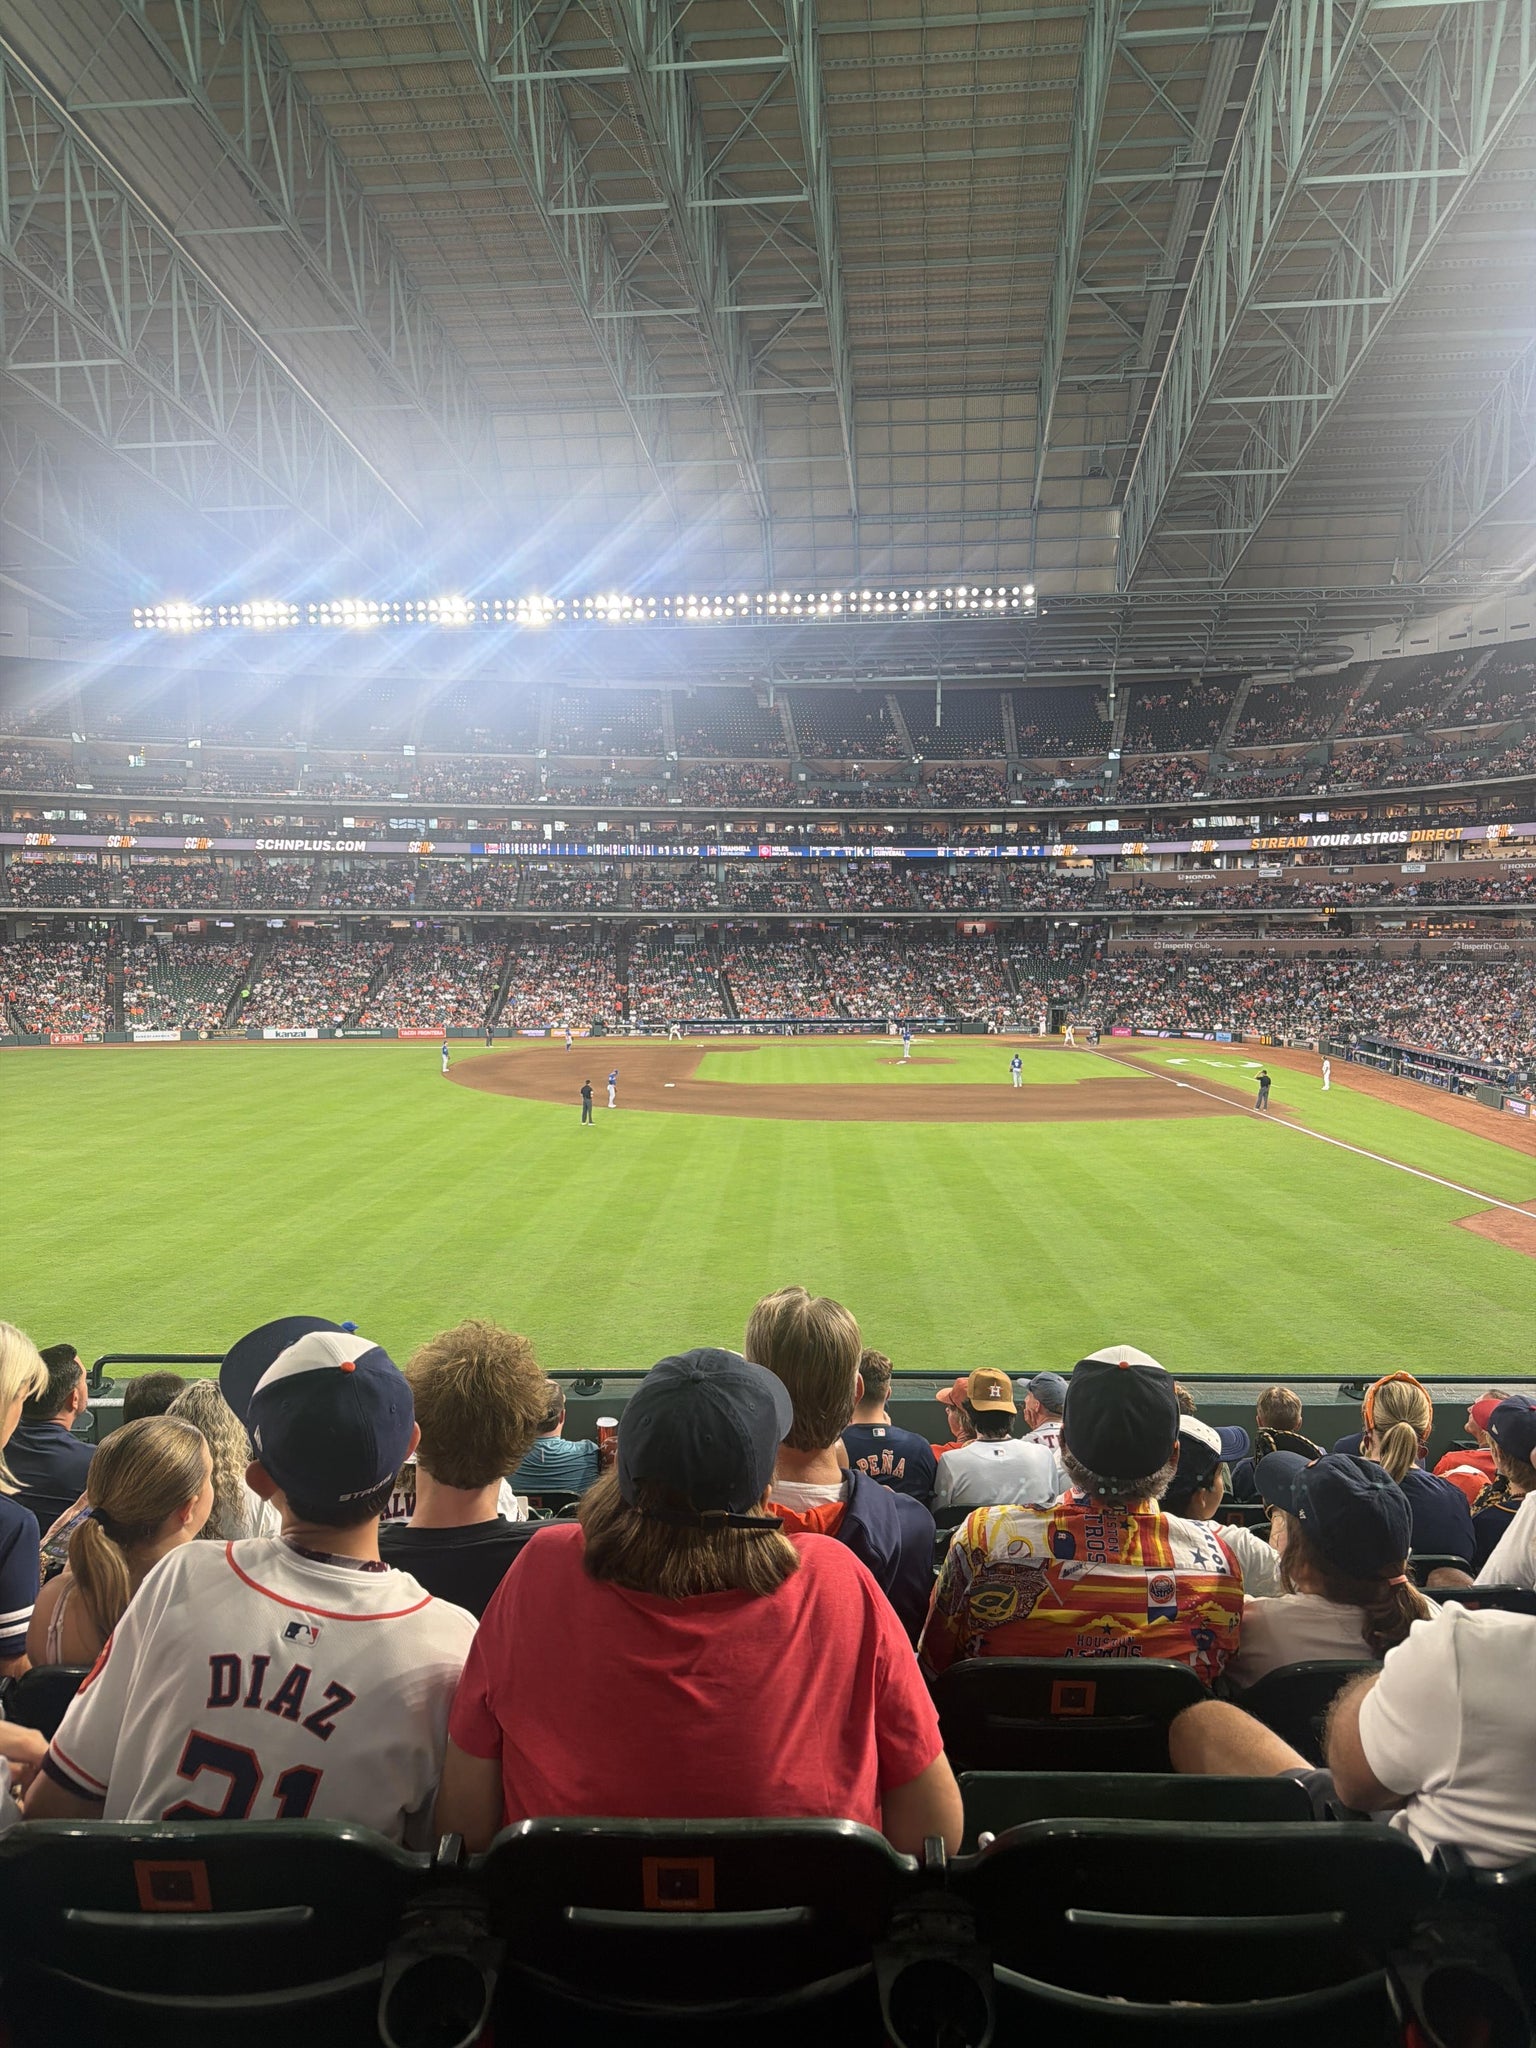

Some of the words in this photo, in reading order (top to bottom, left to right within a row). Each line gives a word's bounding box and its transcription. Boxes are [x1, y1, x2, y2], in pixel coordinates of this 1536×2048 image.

[255, 839, 366, 852] SCHNPLUS.COM
[1251, 837, 1308, 850] STREAM
[1312, 834, 1350, 847] YOUR
[1353, 831, 1407, 845] ASTROS
[1410, 828, 1463, 842] DIRECT
[1162, 942, 1193, 950] Insperity
[1194, 941, 1210, 949] Club
[1461, 942, 1492, 950] Insperity
[855, 1448, 906, 1479] PEÑA
[206, 1652, 357, 1742] DIAZ
